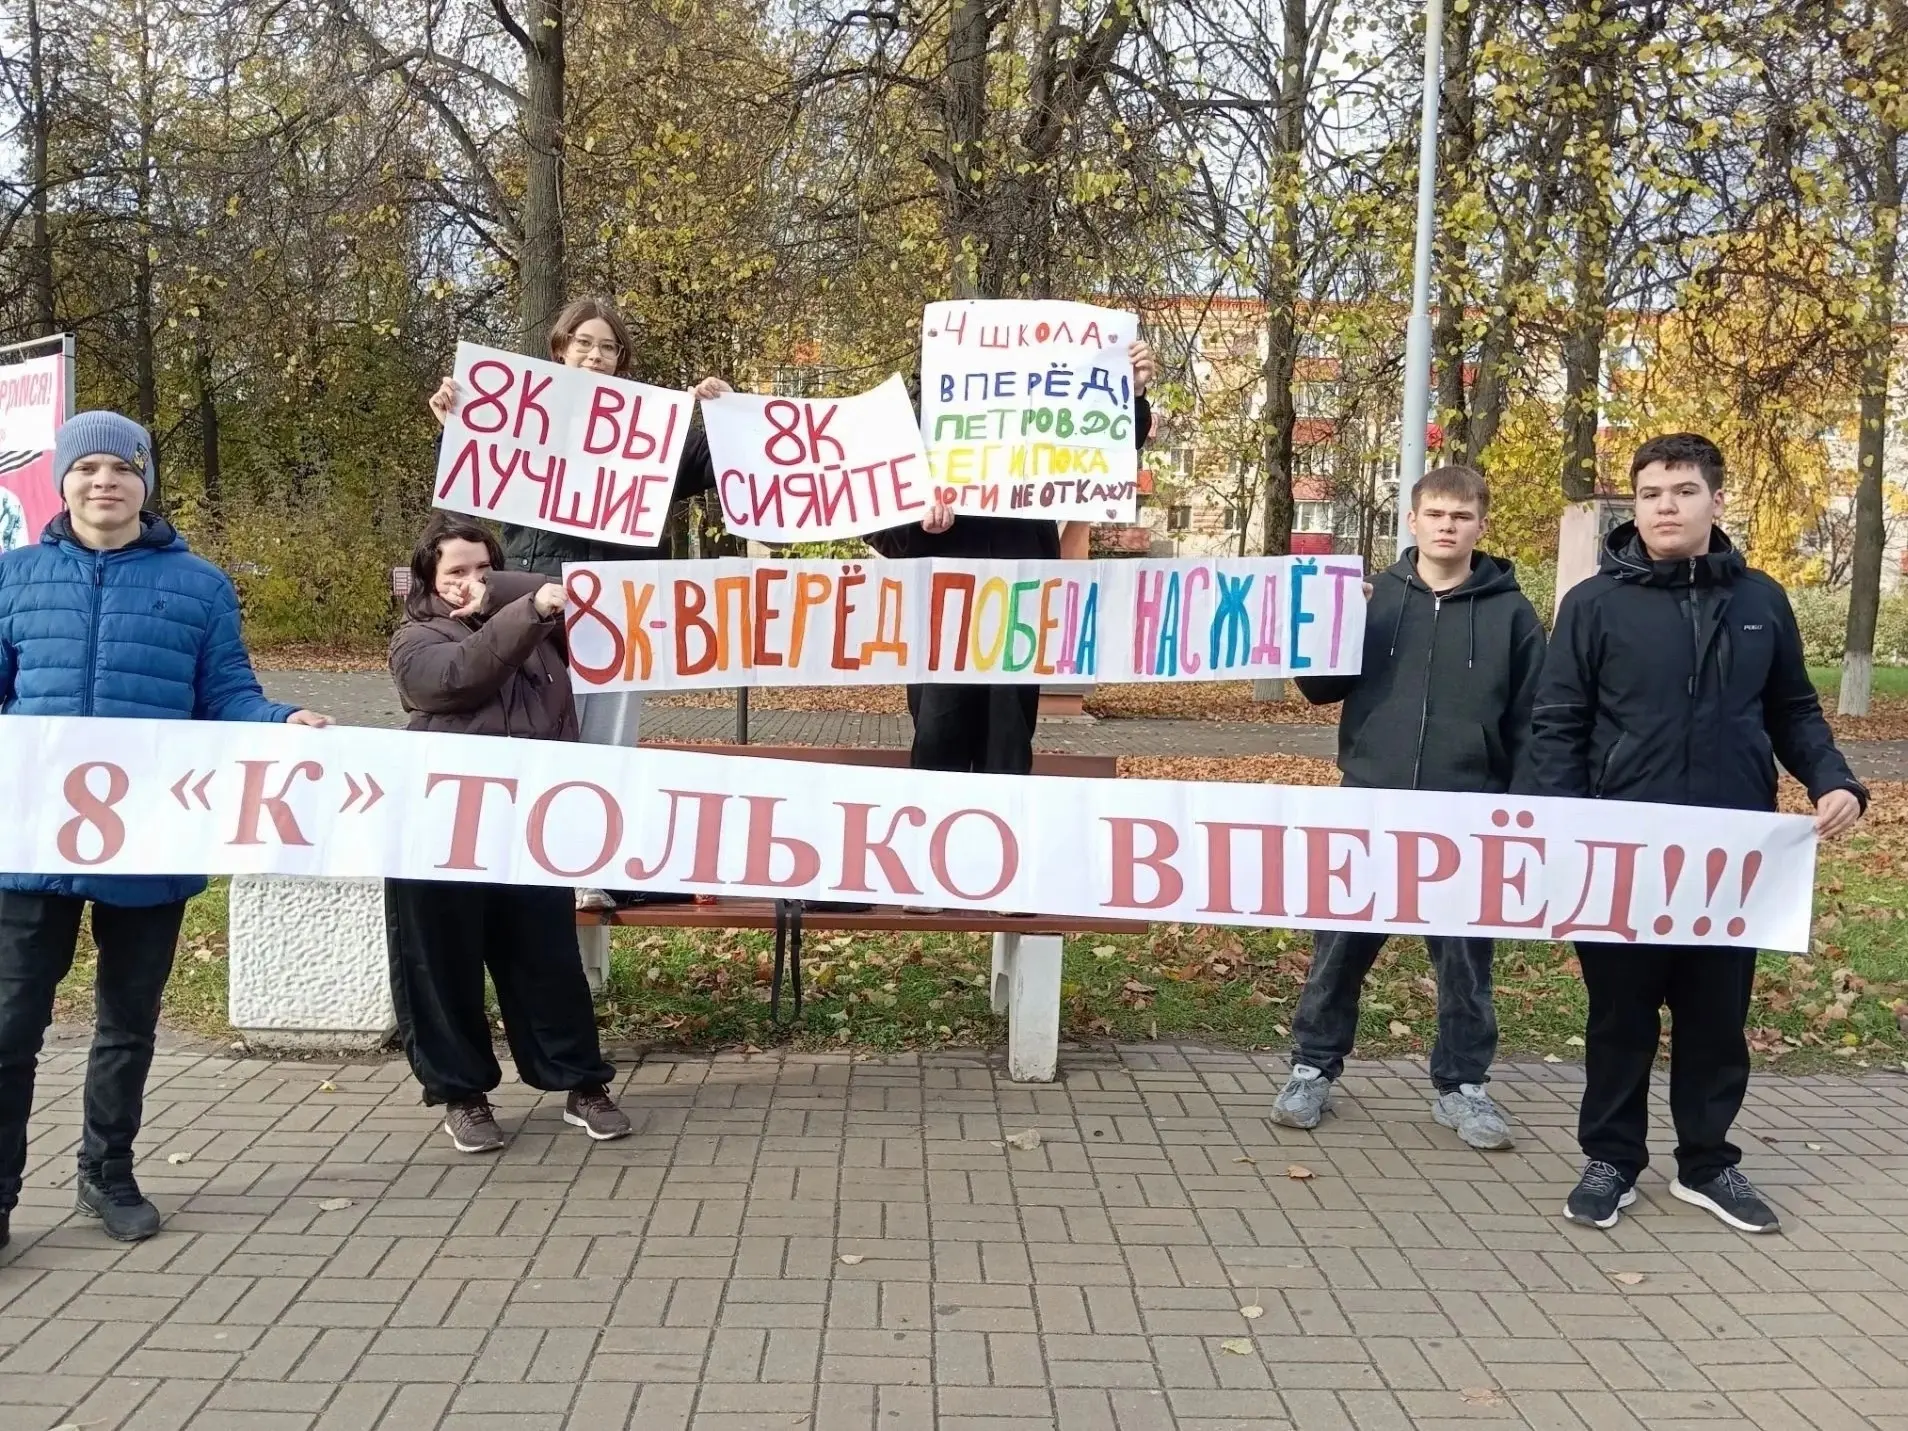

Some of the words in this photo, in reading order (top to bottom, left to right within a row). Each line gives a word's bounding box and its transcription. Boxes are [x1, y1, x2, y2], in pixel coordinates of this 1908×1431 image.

[980, 321, 1102, 350] ШКОЛА
[461, 360, 554, 446] 8К
[583, 386, 678, 464] ВЫ
[940, 361, 1130, 410] ВПЕРЁД!
[763, 399, 845, 467] 8К
[438, 438, 669, 538] ЛУЧШИЕ
[720, 453, 926, 529] СИЯЙТЕ
[1010, 483, 1035, 509] НЕ
[1039, 478, 1137, 508] ОТКАЖУТ
[927, 571, 1098, 675] ПОБЕДА
[56, 760, 131, 866] 8
[424, 772, 1019, 901] ТОЛЬКО
[1098, 808, 1764, 942] ВПЕРЁД!!!
